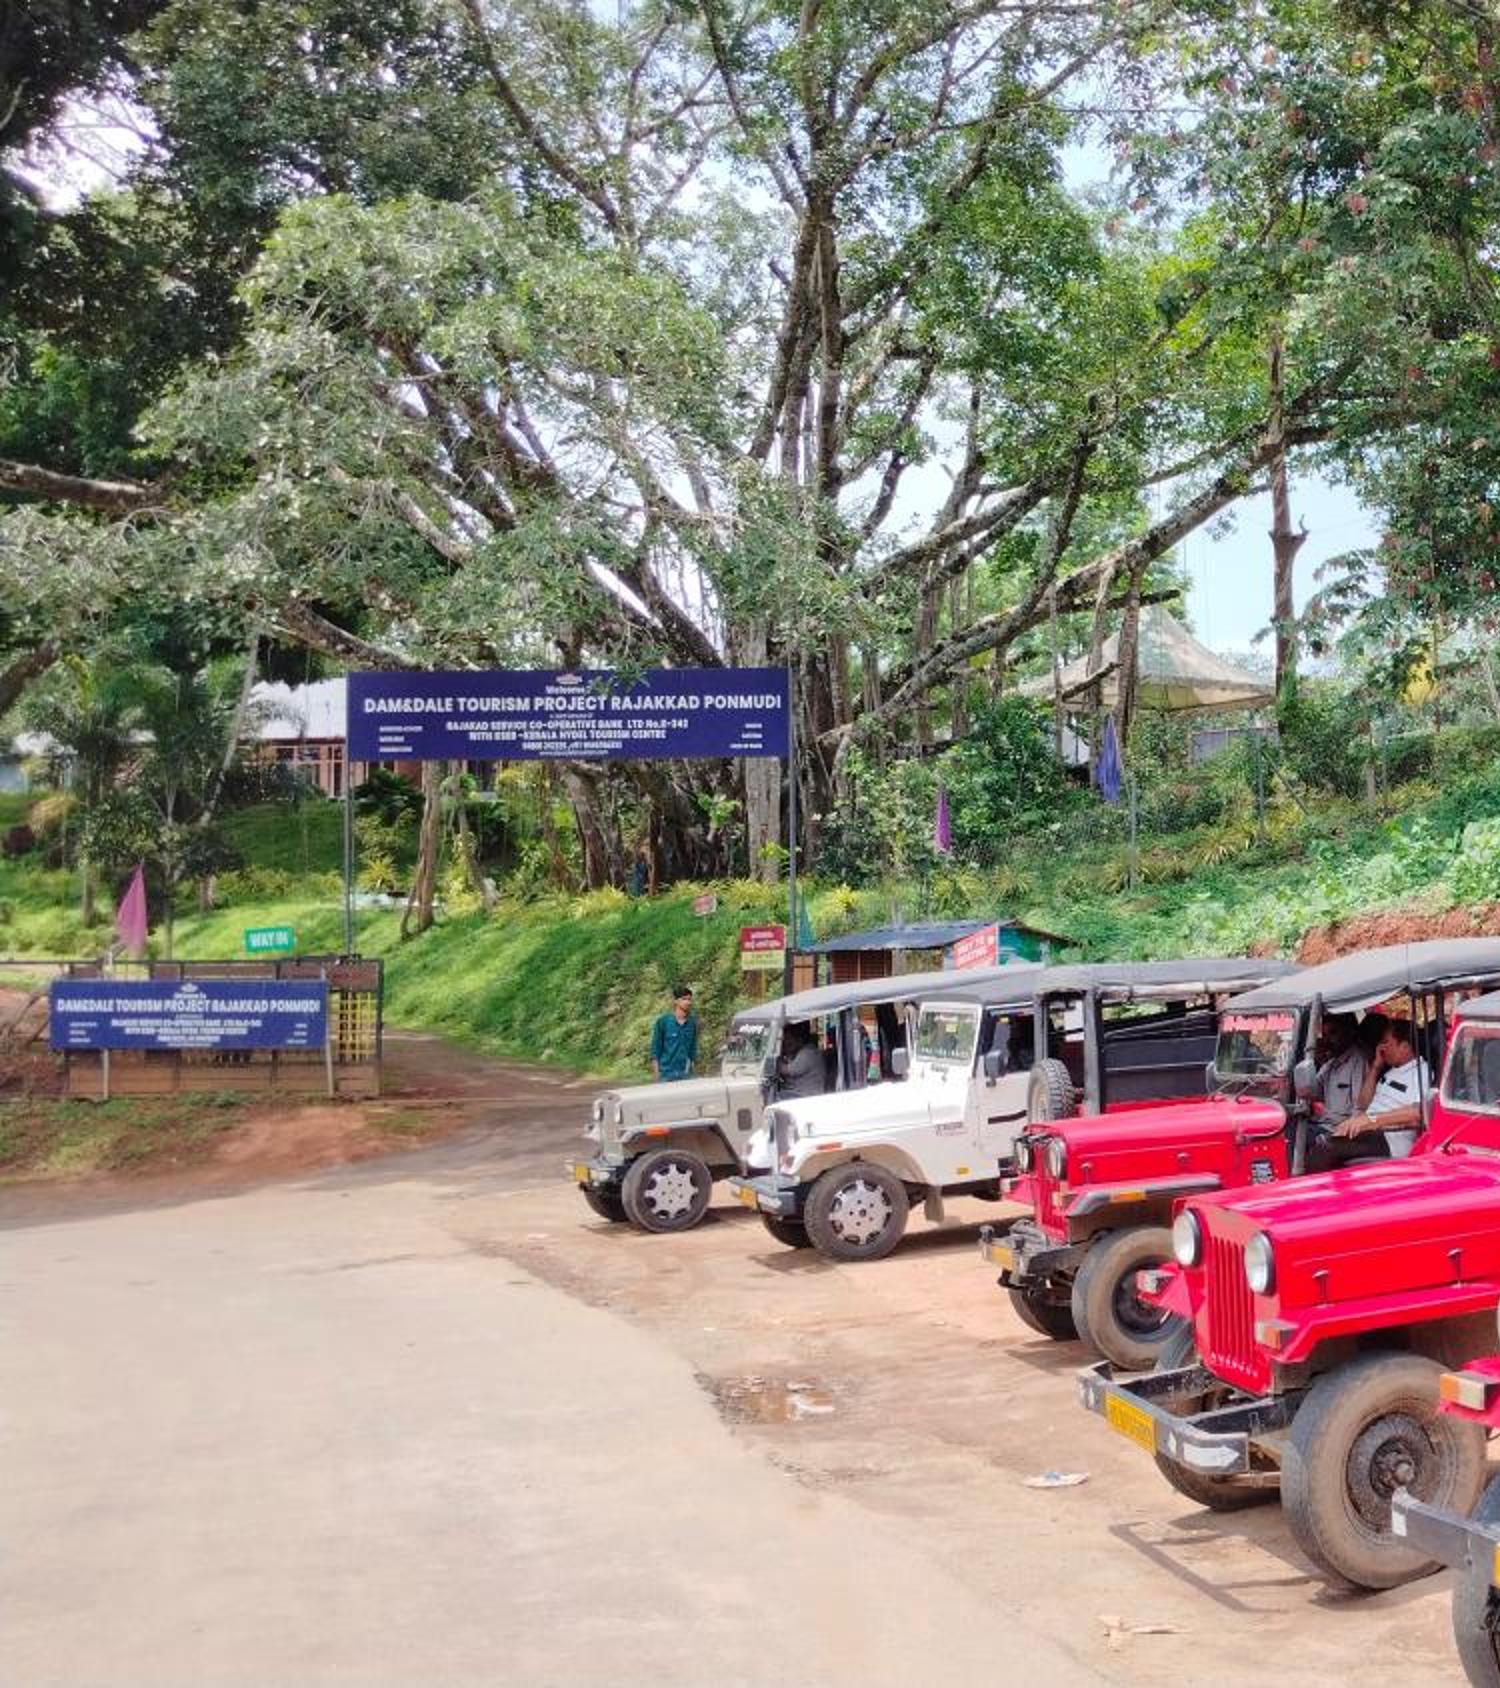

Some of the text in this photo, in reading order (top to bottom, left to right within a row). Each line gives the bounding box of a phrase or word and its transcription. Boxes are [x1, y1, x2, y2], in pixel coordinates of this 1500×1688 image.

[458, 697, 531, 712] TOURISM
[534, 695, 608, 711] PROJECT
[611, 695, 700, 711] RAJAKKAD
[704, 695, 781, 710] PONMUDI
[249, 931, 274, 947] WAY
[116, 999, 162, 1012] TOURISM
[164, 999, 211, 1012] PROJECT
[270, 1000, 321, 1013] PONMUDI
